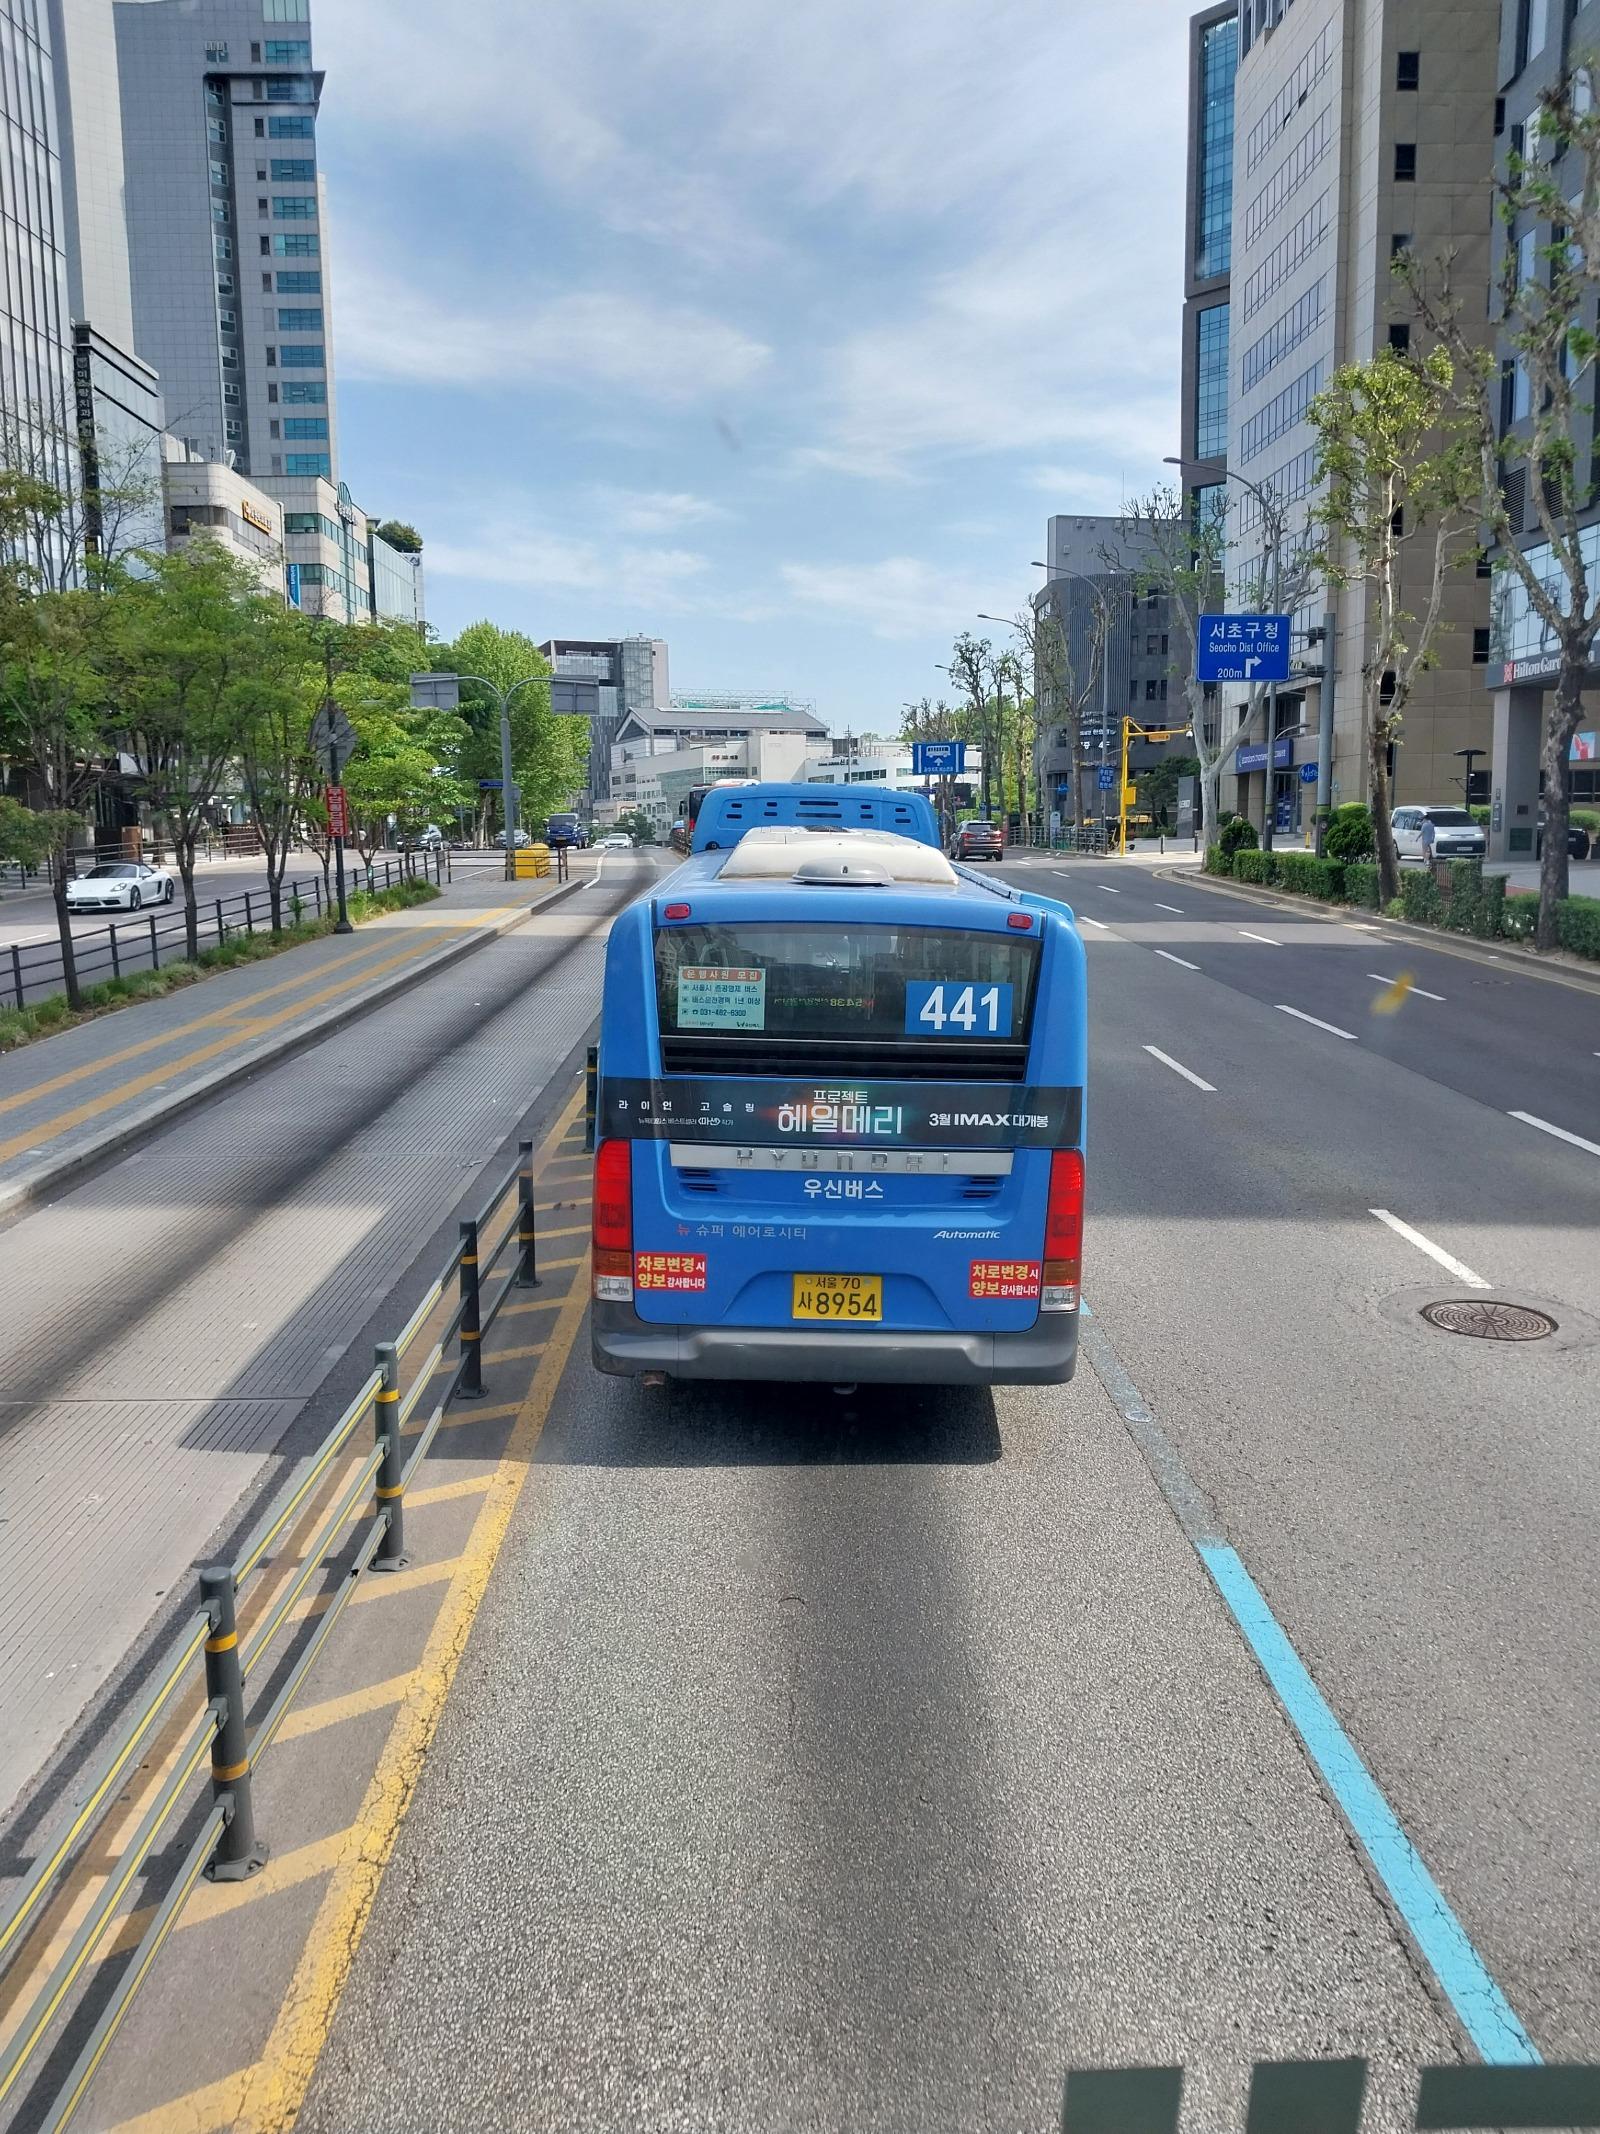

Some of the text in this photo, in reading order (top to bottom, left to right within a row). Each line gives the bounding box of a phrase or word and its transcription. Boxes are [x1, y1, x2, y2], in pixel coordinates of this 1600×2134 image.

[1210, 622, 1278, 639] 서초구청
[1209, 642, 1280, 652] Seocho Dist Office
[1217, 668, 1242, 678] 200m
[1514, 661, 1540, 678] Hilton
[737, 971, 758, 980] 모집
[919, 985, 999, 1032] 441
[814, 1090, 868, 1104] 프로젝트
[778, 1104, 902, 1134] 헤일메리
[928, 1113, 1048, 1128] 3월 IMAX 대개봉
[736, 1148, 951, 1172] HYUNDAI
[804, 1179, 884, 1200] 우신버스
[677, 1224, 807, 1239] 뉴 슈퍼 에어로시티
[933, 1229, 1001, 1239] Automatic
[638, 1273, 706, 1288] 양보 감사합니다
[816, 1277, 860, 1289] 서울 70
[972, 1280, 1038, 1296] 양보 감사합니다
